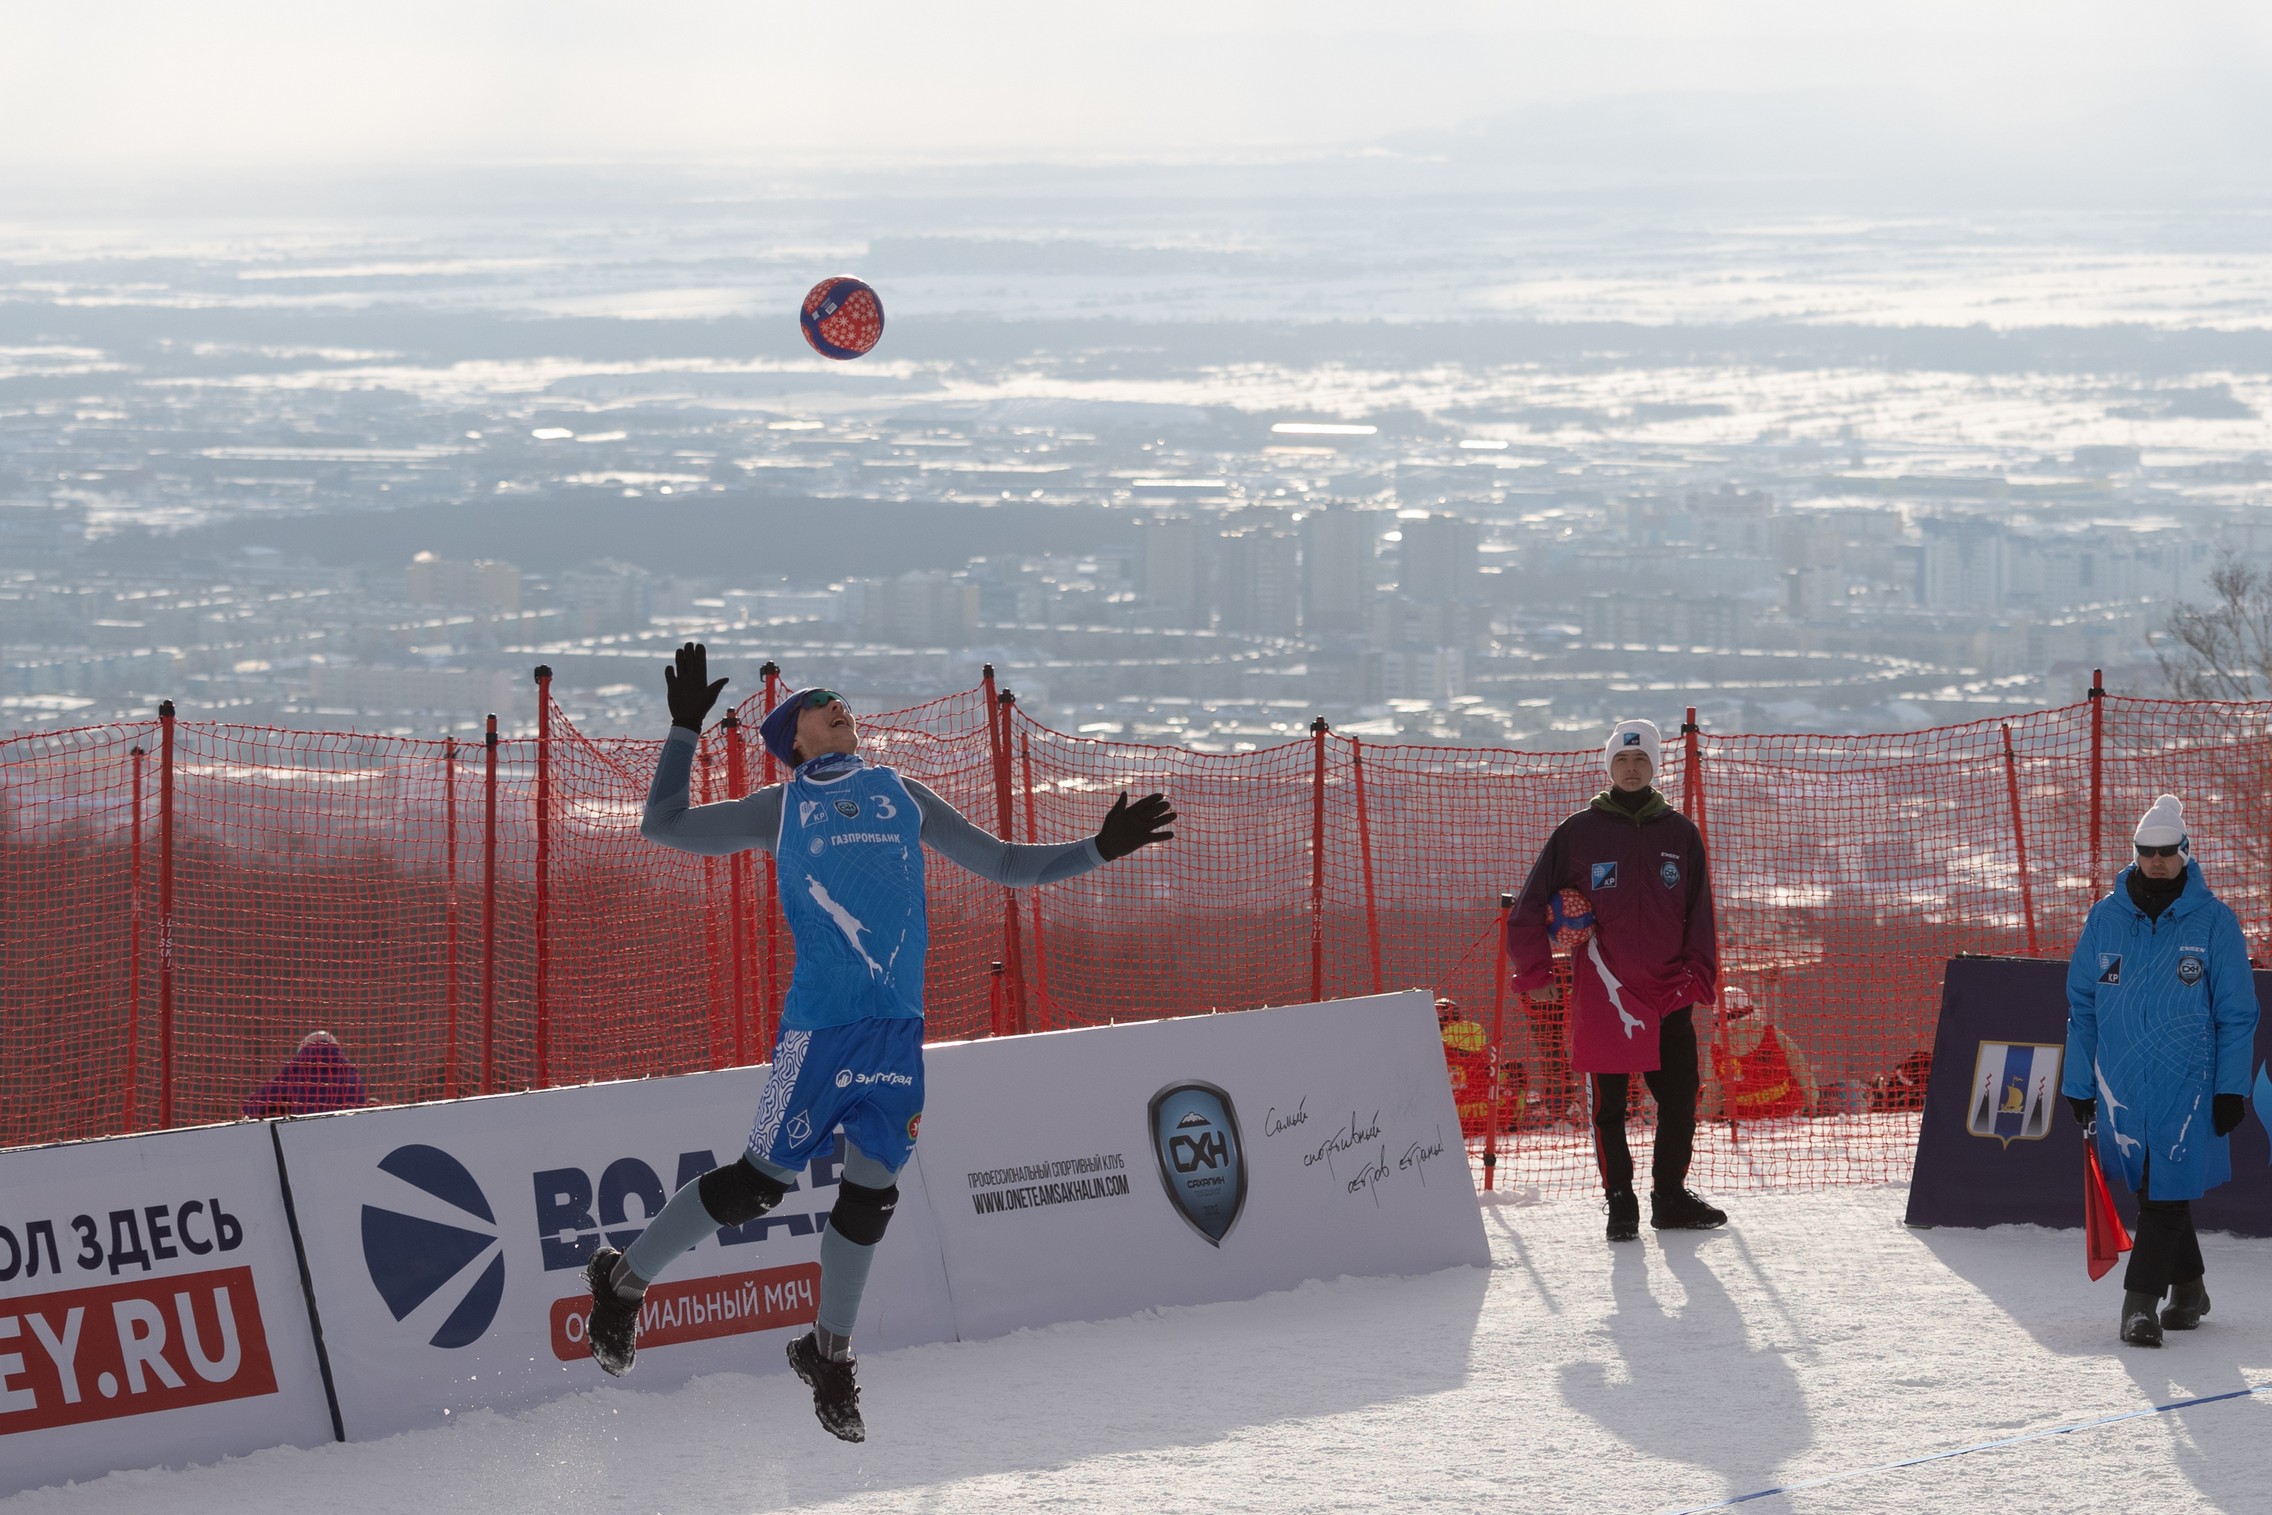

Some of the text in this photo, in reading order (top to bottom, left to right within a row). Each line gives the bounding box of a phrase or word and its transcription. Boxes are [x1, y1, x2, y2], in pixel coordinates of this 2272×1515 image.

[869, 795, 897, 819] 3
[830, 833, 900, 846] ГАЗПРОМБАНК
[968, 1154, 1124, 1188] ПРОФЕССИОНАЛЬНЫЙ СПОРТИВНЫЙ КЛУБ
[1187, 1176, 1225, 1188] САХАЛИН
[972, 1174, 1130, 1214] WWW.ONETEAMSAKHALIN.COM
[71, 1198, 243, 1275] ЗДЕСЬ
[566, 1278, 813, 1342] ОИАЛЬНЫЙ МЯЧ
[0, 1286, 241, 1415] EY.RU
